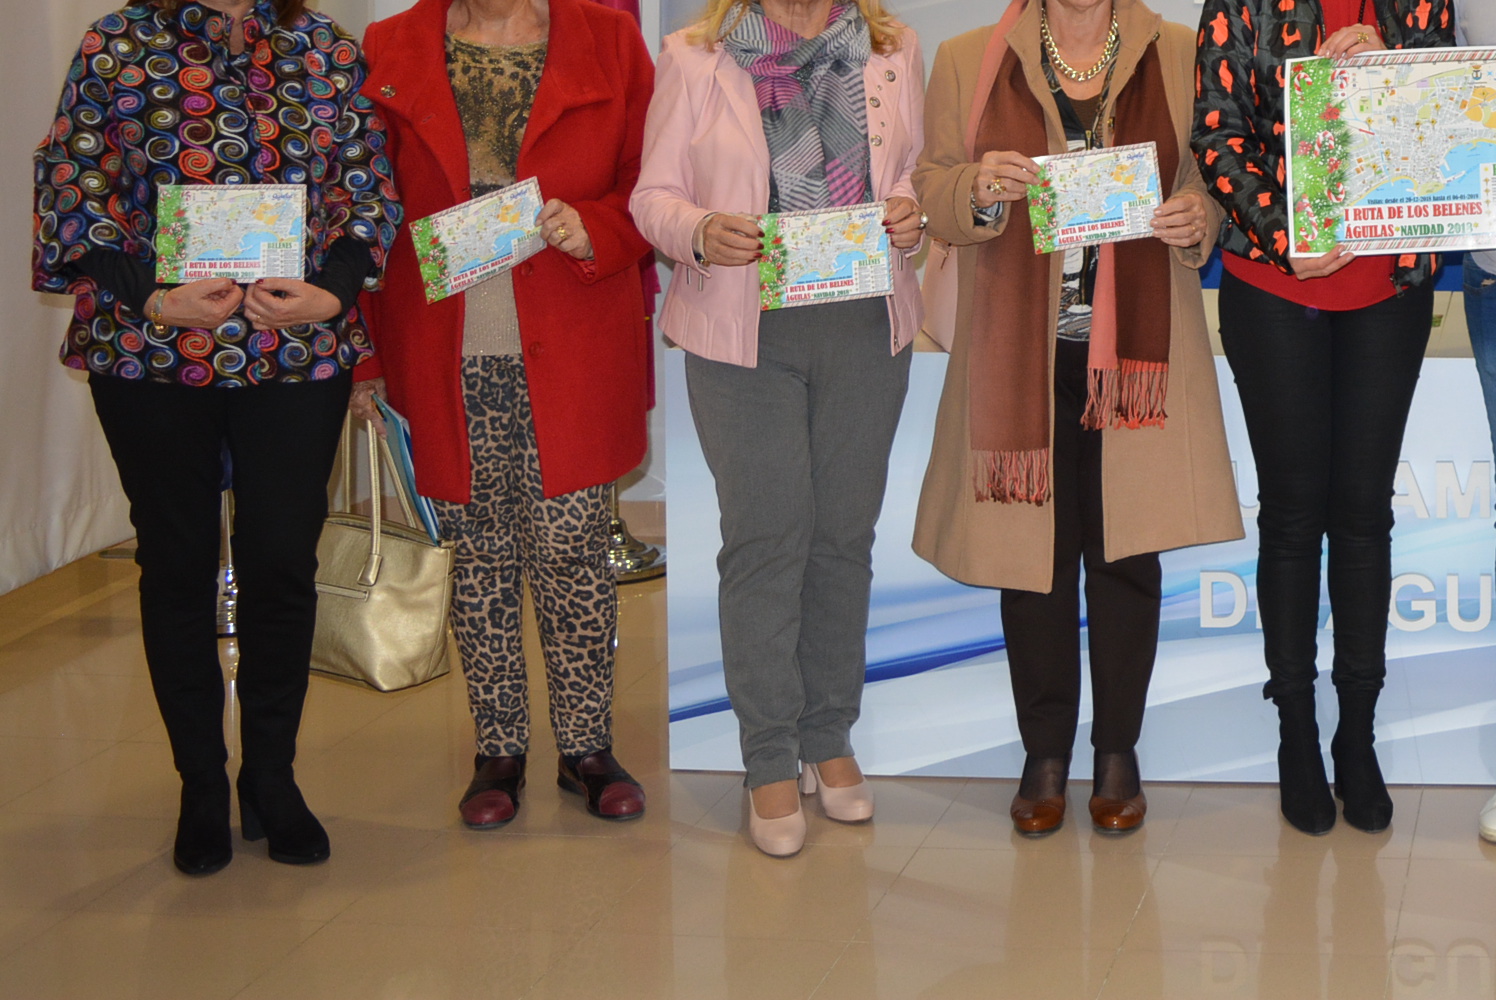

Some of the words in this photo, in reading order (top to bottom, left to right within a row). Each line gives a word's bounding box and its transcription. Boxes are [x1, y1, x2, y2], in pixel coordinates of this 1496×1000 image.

[1344, 208, 1350, 221] I
[1353, 206, 1384, 221] RUTA
[1388, 205, 1404, 219] DE
[1407, 204, 1430, 218] LOS
[1432, 202, 1482, 216] BELENES
[1345, 224, 1395, 239] ÁGUILAS
[1400, 222, 1444, 236] NAVIDAD
